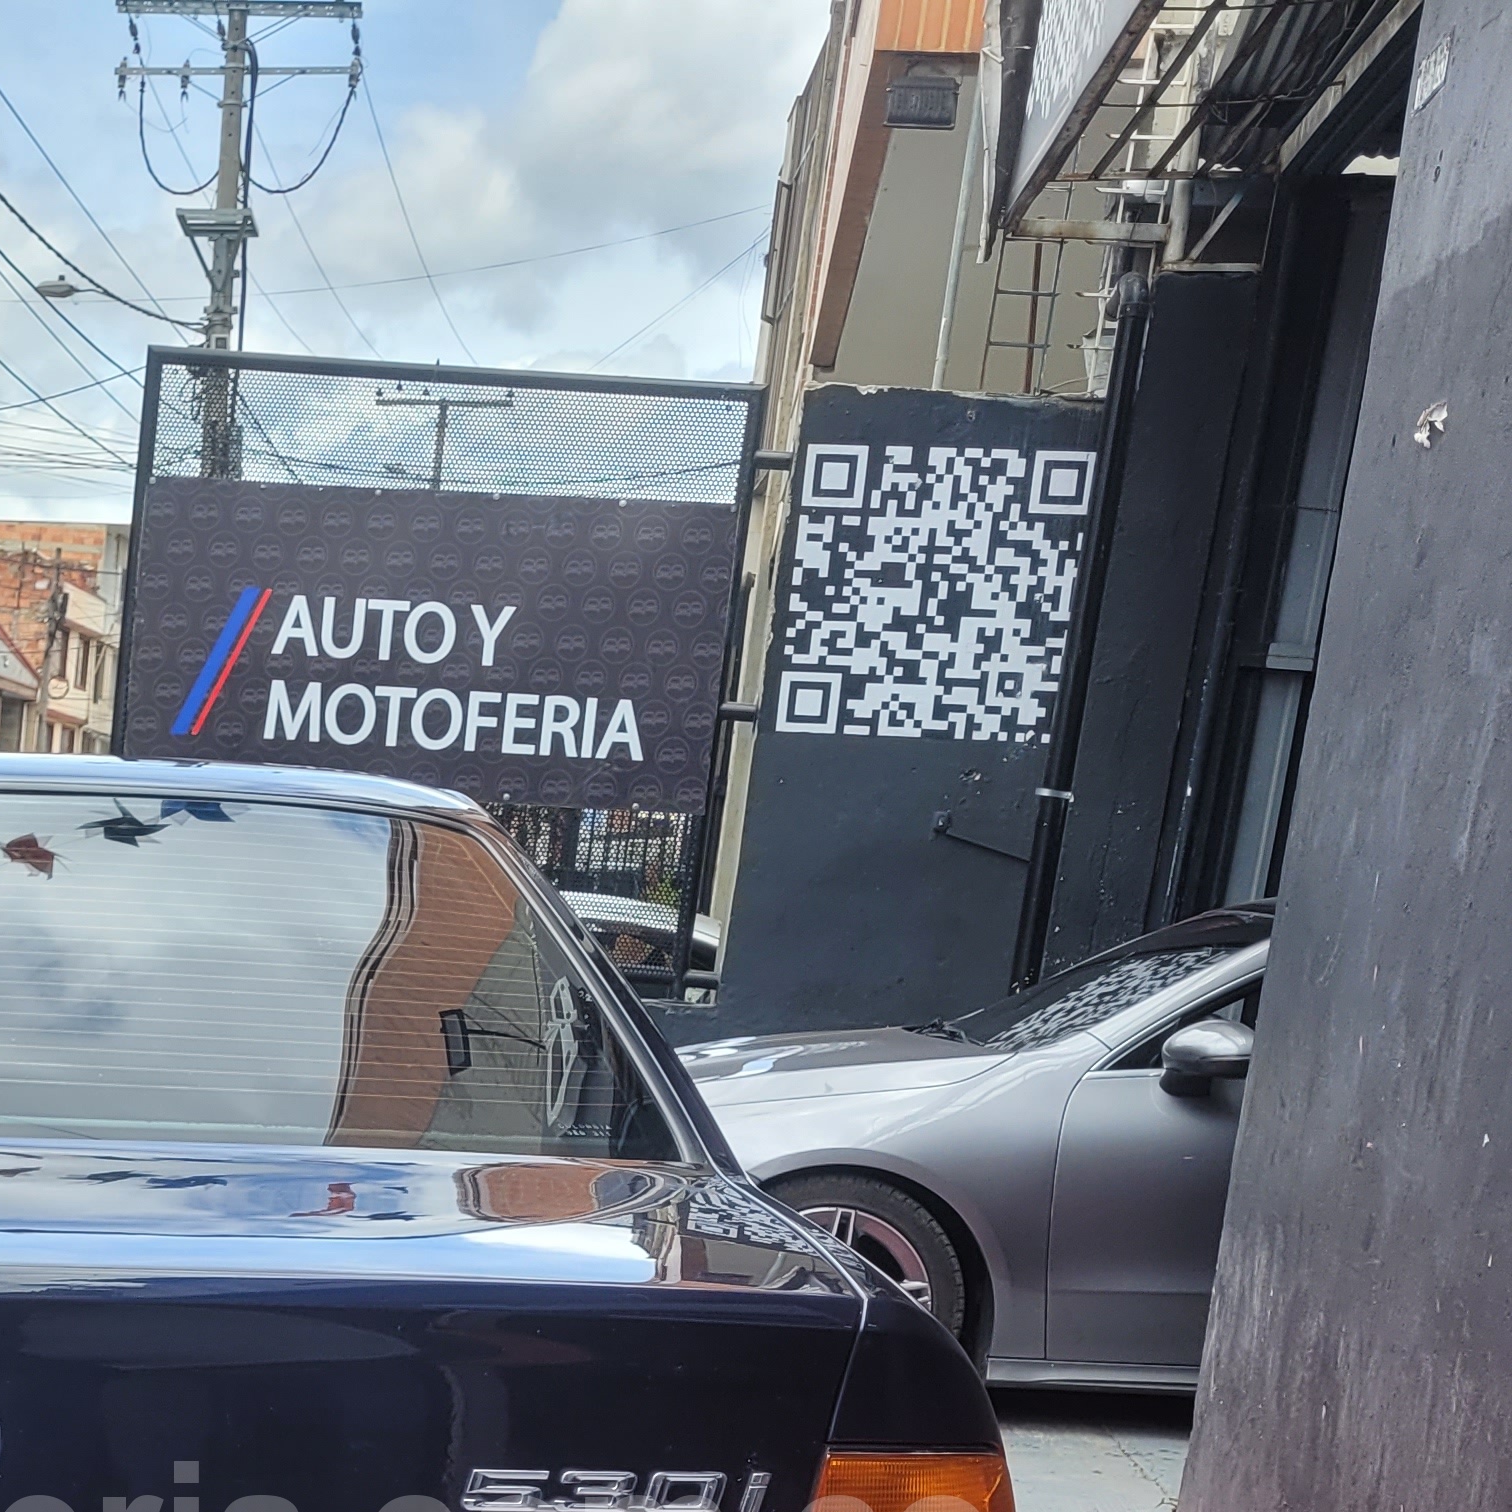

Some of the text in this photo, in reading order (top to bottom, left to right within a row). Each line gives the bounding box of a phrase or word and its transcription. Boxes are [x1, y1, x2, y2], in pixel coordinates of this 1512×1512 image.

[272, 594, 518, 667] AUTO Y
[263, 679, 644, 762] MOTOFERIA
